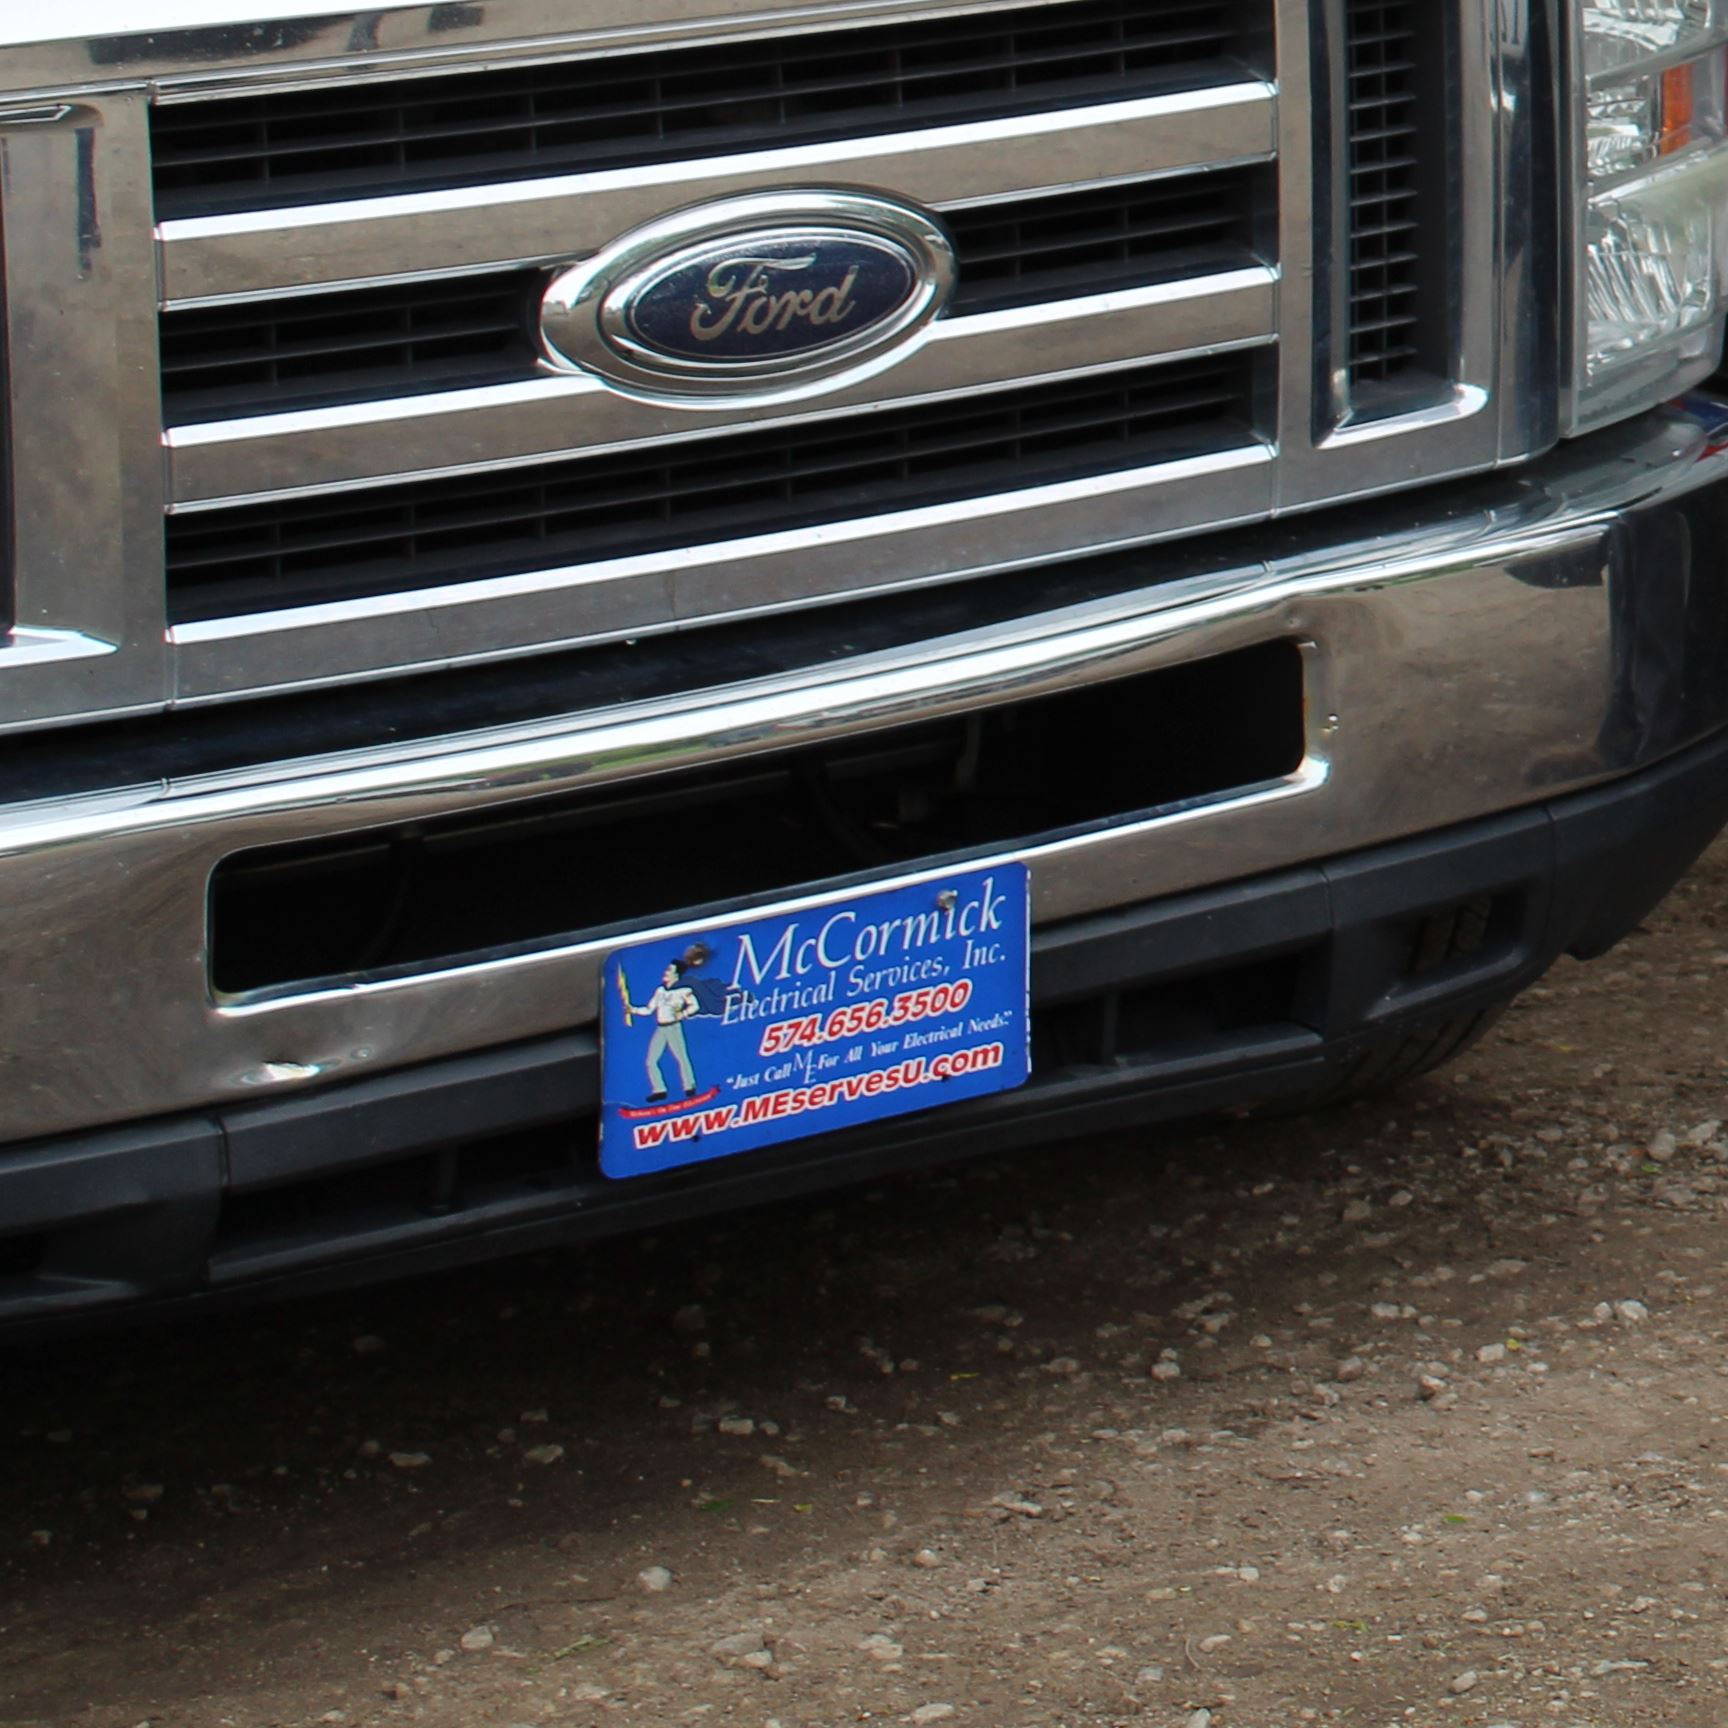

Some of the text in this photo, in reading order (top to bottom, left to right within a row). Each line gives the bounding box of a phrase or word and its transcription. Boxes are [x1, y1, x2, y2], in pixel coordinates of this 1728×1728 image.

[688, 253, 859, 342] Ford
[727, 877, 1007, 991] McCormick
[720, 939, 1006, 1026] Electrical Services, Inc.
[759, 978, 972, 1056] 574.656.3500
[632, 1041, 1005, 1150] www.MEservesU.com
[764, 1062, 793, 1083] Call
[817, 1052, 840, 1071] For
[843, 1047, 863, 1064] All
[870, 1038, 899, 1059] Your
[903, 1022, 963, 1050] Electrical
